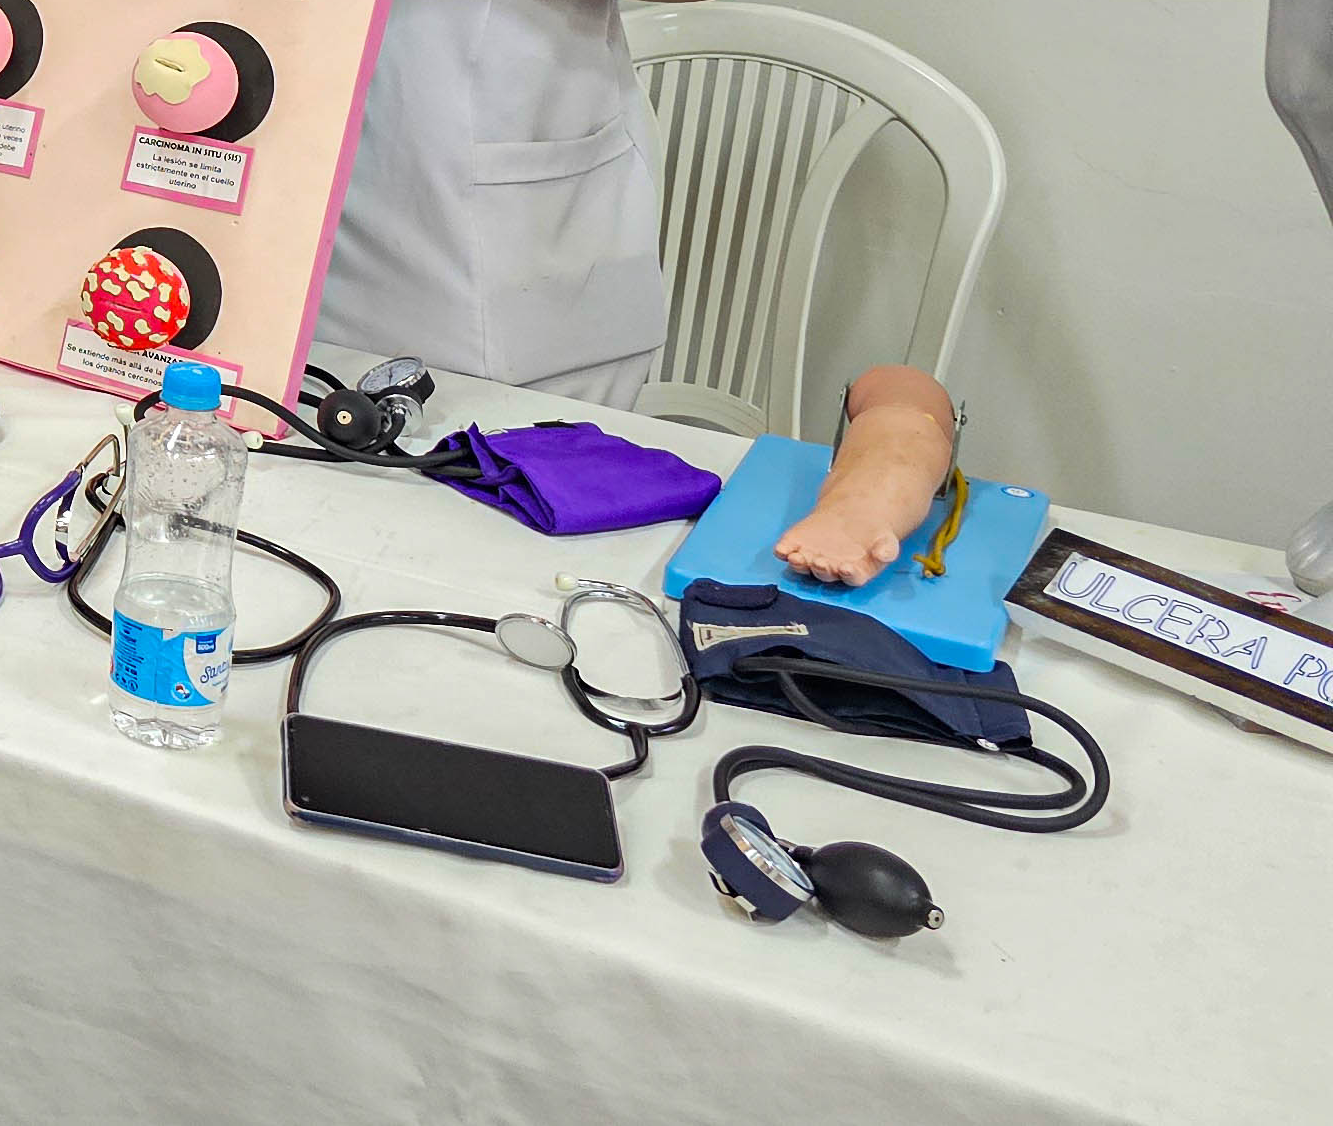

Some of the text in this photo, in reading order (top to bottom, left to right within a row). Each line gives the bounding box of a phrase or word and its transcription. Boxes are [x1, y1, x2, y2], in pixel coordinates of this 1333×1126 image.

[138, 136, 191, 154] CARCINOMA
[192, 146, 203, 155] IN
[203, 148, 222, 159] SITU
[153, 153, 162, 162] La
[189, 161, 199, 169] se
[189, 172, 200, 180] en
[201, 173, 209, 182] el
[66, 343, 77, 352] Se
[78, 346, 110, 362] extiende
[143, 364, 154, 374] de
[82, 358, 94, 368] los
[1057, 561, 1268, 671] ULCERA
